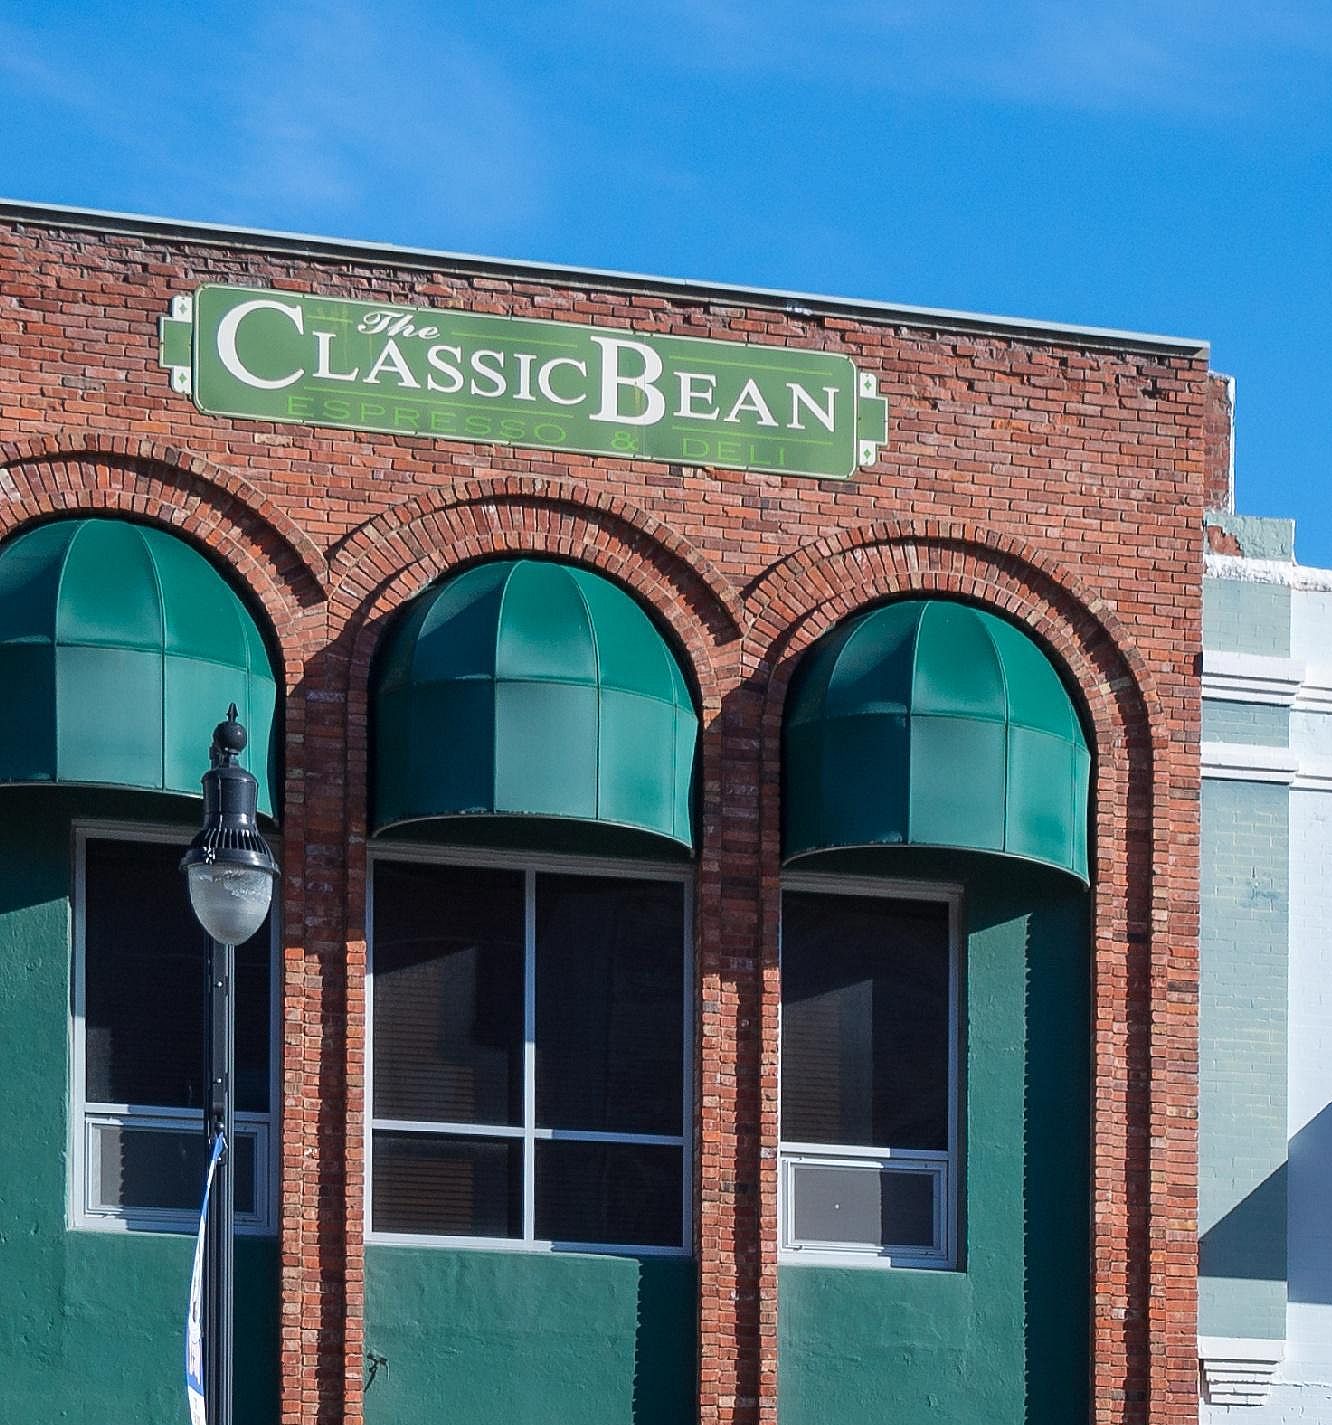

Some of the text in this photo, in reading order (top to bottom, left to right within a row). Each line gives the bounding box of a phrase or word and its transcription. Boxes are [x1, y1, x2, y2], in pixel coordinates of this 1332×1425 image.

[357, 309, 441, 343] The
[217, 299, 840, 432] CLASSIC BEAN
[286, 395, 786, 466] ESPRESSO & DELI
